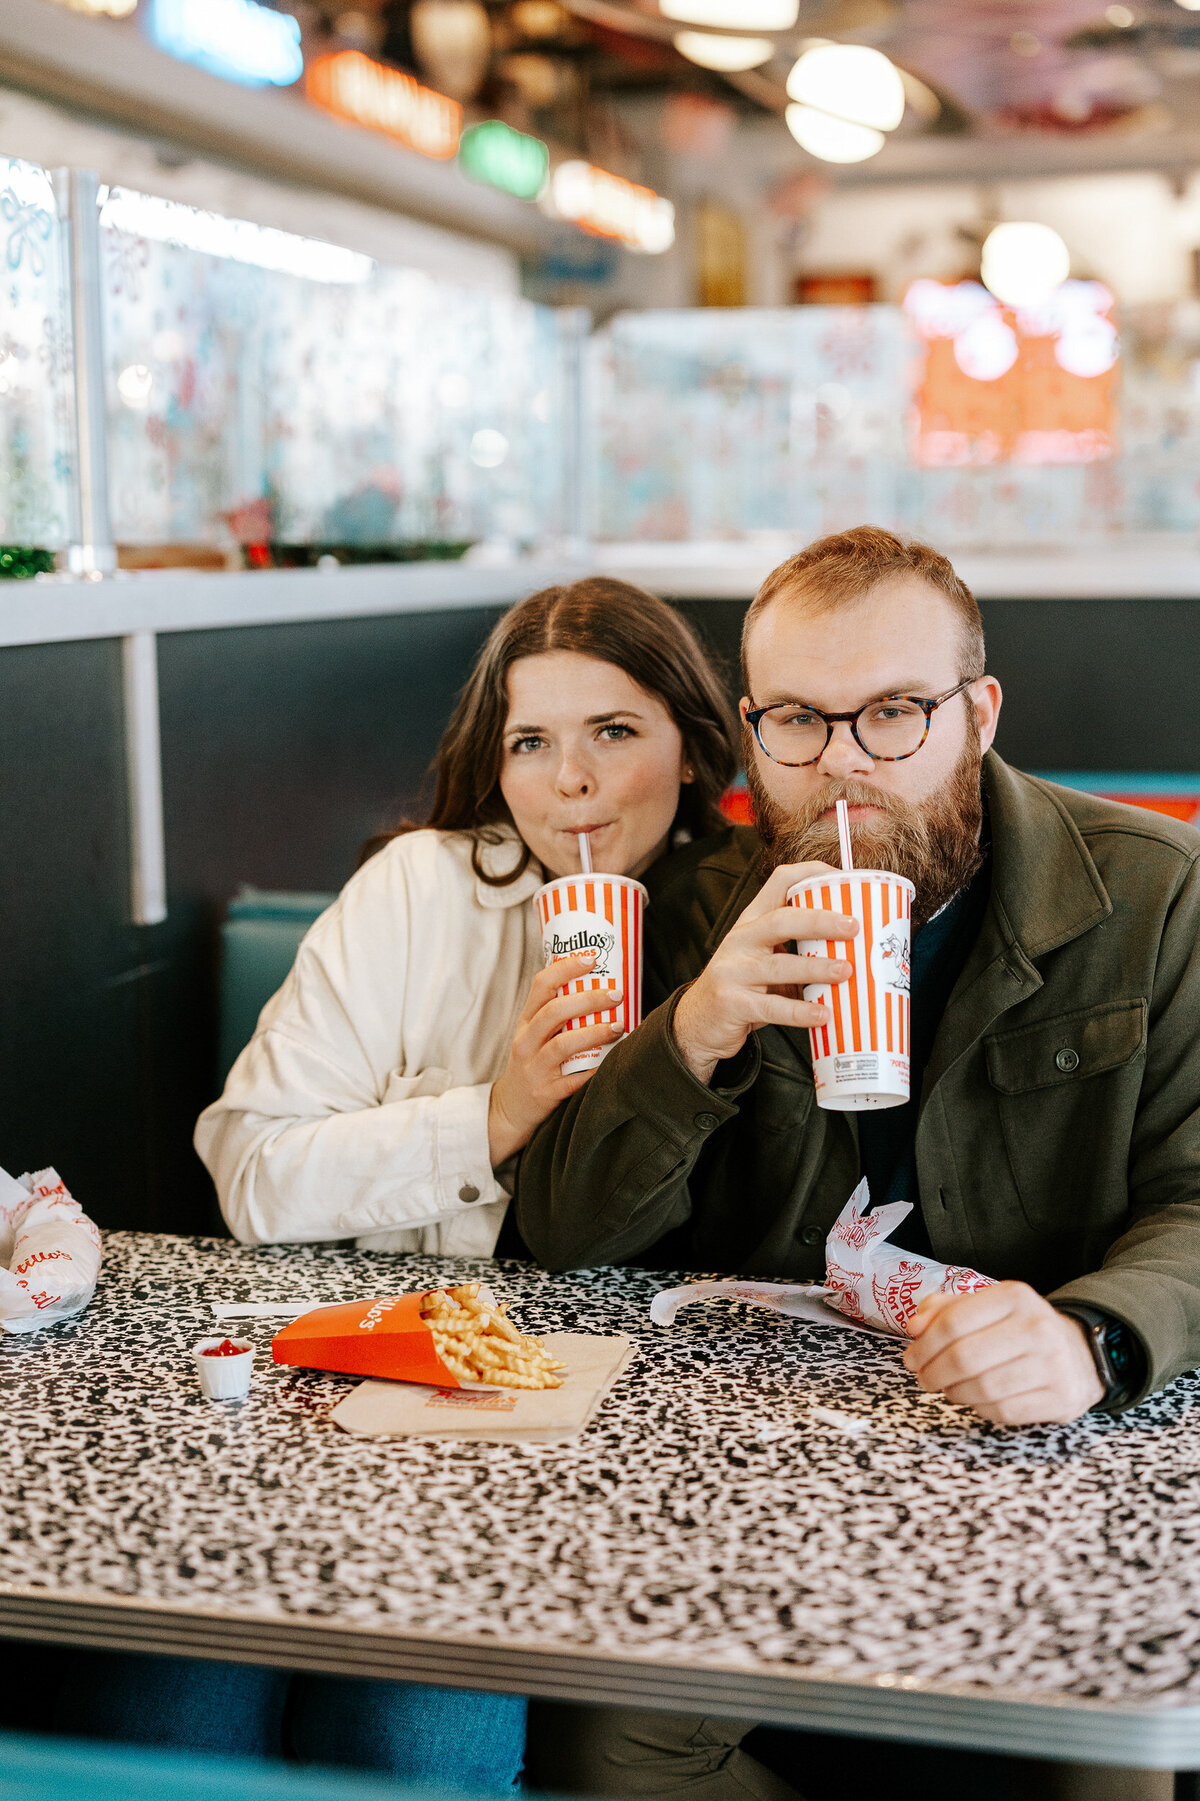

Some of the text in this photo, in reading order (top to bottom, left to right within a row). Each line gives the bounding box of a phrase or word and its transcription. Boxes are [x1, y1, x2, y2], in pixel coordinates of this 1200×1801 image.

[552, 930, 608, 954] Portillo's
[16, 1250, 73, 1275] tillo's
[359, 1296, 400, 1330] illo's
[888, 1286, 907, 1329] HOT DO
[900, 1280, 922, 1319] Porti
